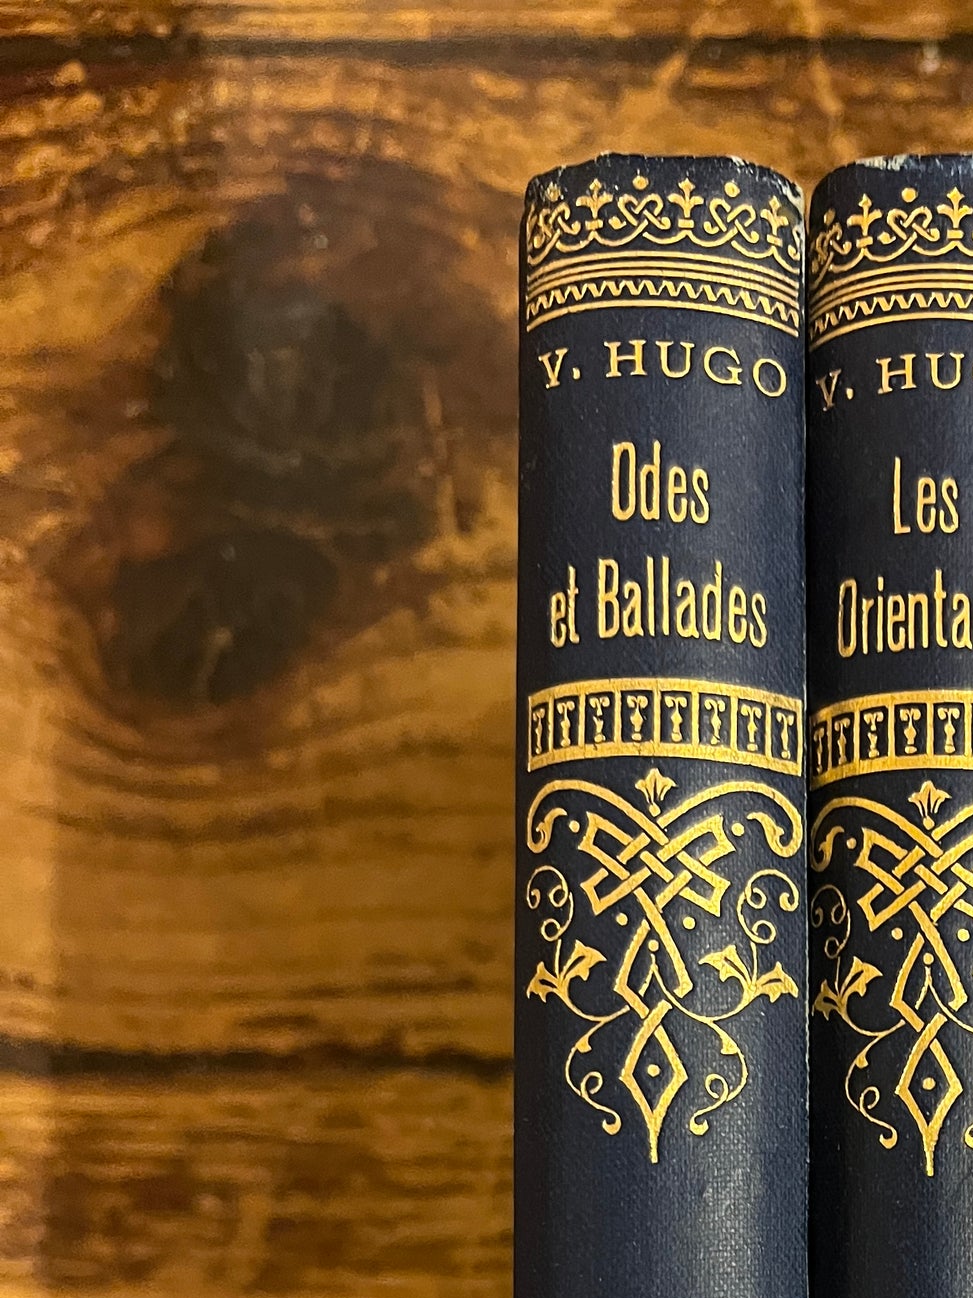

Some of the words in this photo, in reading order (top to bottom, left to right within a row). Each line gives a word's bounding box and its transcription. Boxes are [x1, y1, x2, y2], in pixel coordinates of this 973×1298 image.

[538, 348, 581, 389] V.
[604, 340, 787, 397] HUGO
[816, 369, 854, 412] V.
[611, 440, 710, 524] Odes
[893, 456, 959, 534] Les
[550, 563, 580, 648] et
[598, 556, 768, 648] Ballades
